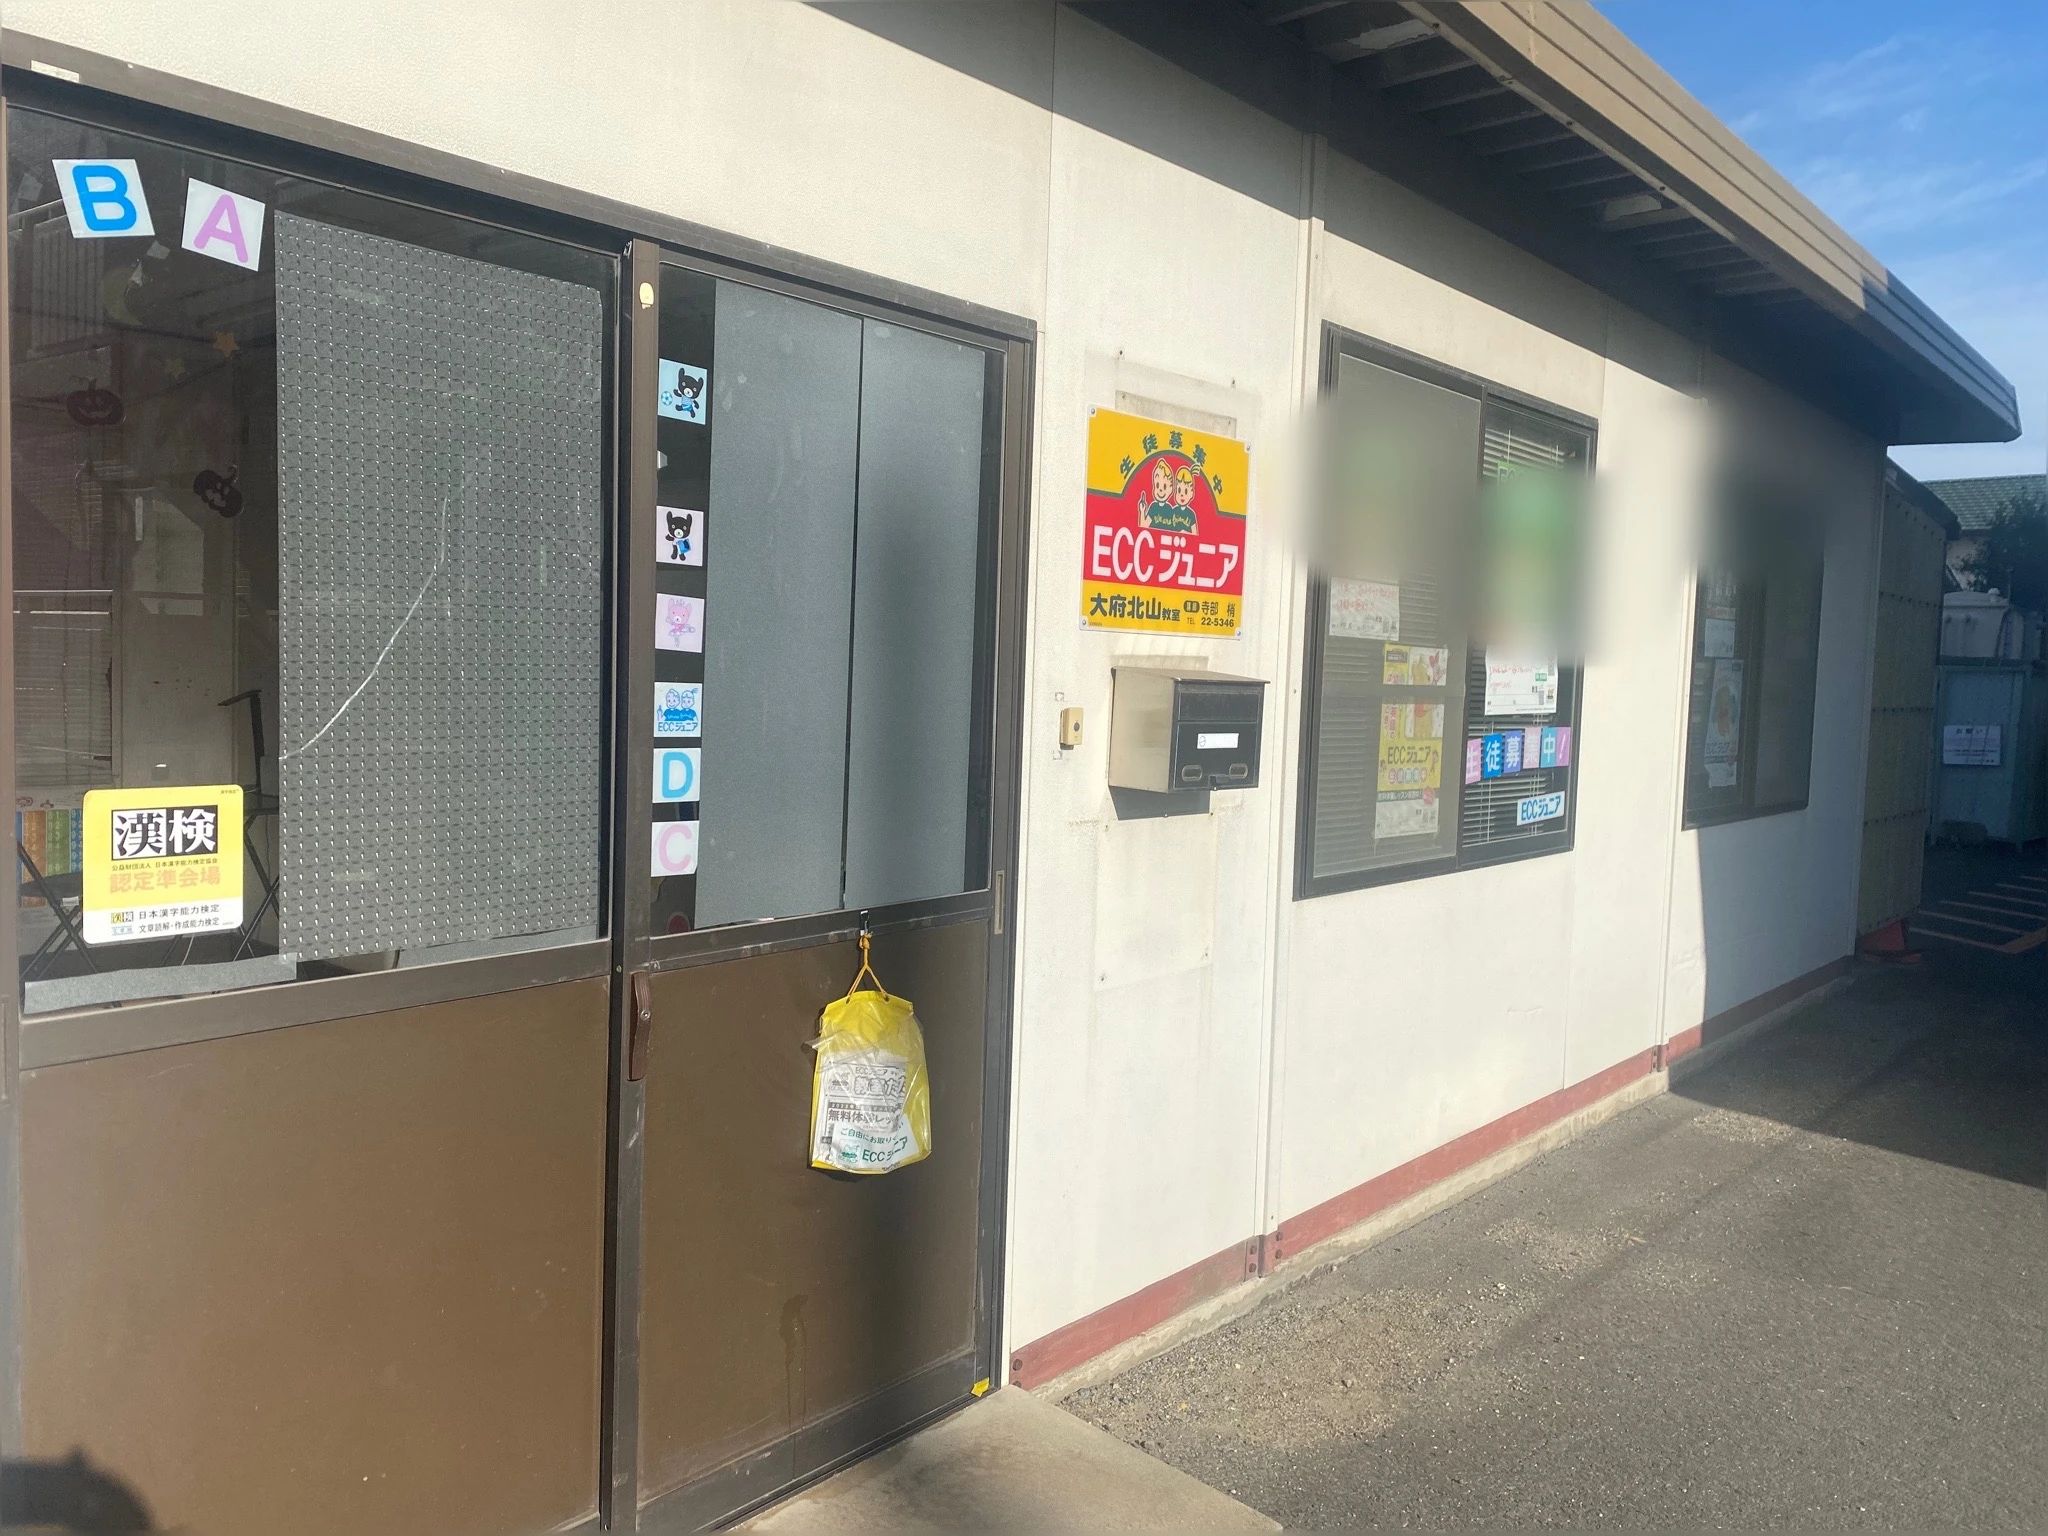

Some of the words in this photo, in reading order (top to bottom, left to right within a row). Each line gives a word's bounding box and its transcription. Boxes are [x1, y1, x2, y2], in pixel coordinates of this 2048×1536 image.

[72, 165, 137, 232] B
[193, 193, 248, 263] A
[1092, 525, 1239, 588] ECCジュニア
[1201, 617, 1235, 628] 22-5346
[657, 721, 698, 732] ECCジュニア
[1387, 745, 1431, 765] ECCジュニア
[662, 751, 693, 799] D
[1521, 796, 1562, 821] ECCジュニア
[114, 808, 216, 857] 漢検
[659, 824, 692, 873] C
[110, 866, 220, 893] 認定準会場
[139, 904, 220, 920] 日本漢字能力検定
[139, 917, 220, 934] 文章読解・作成能力検定
